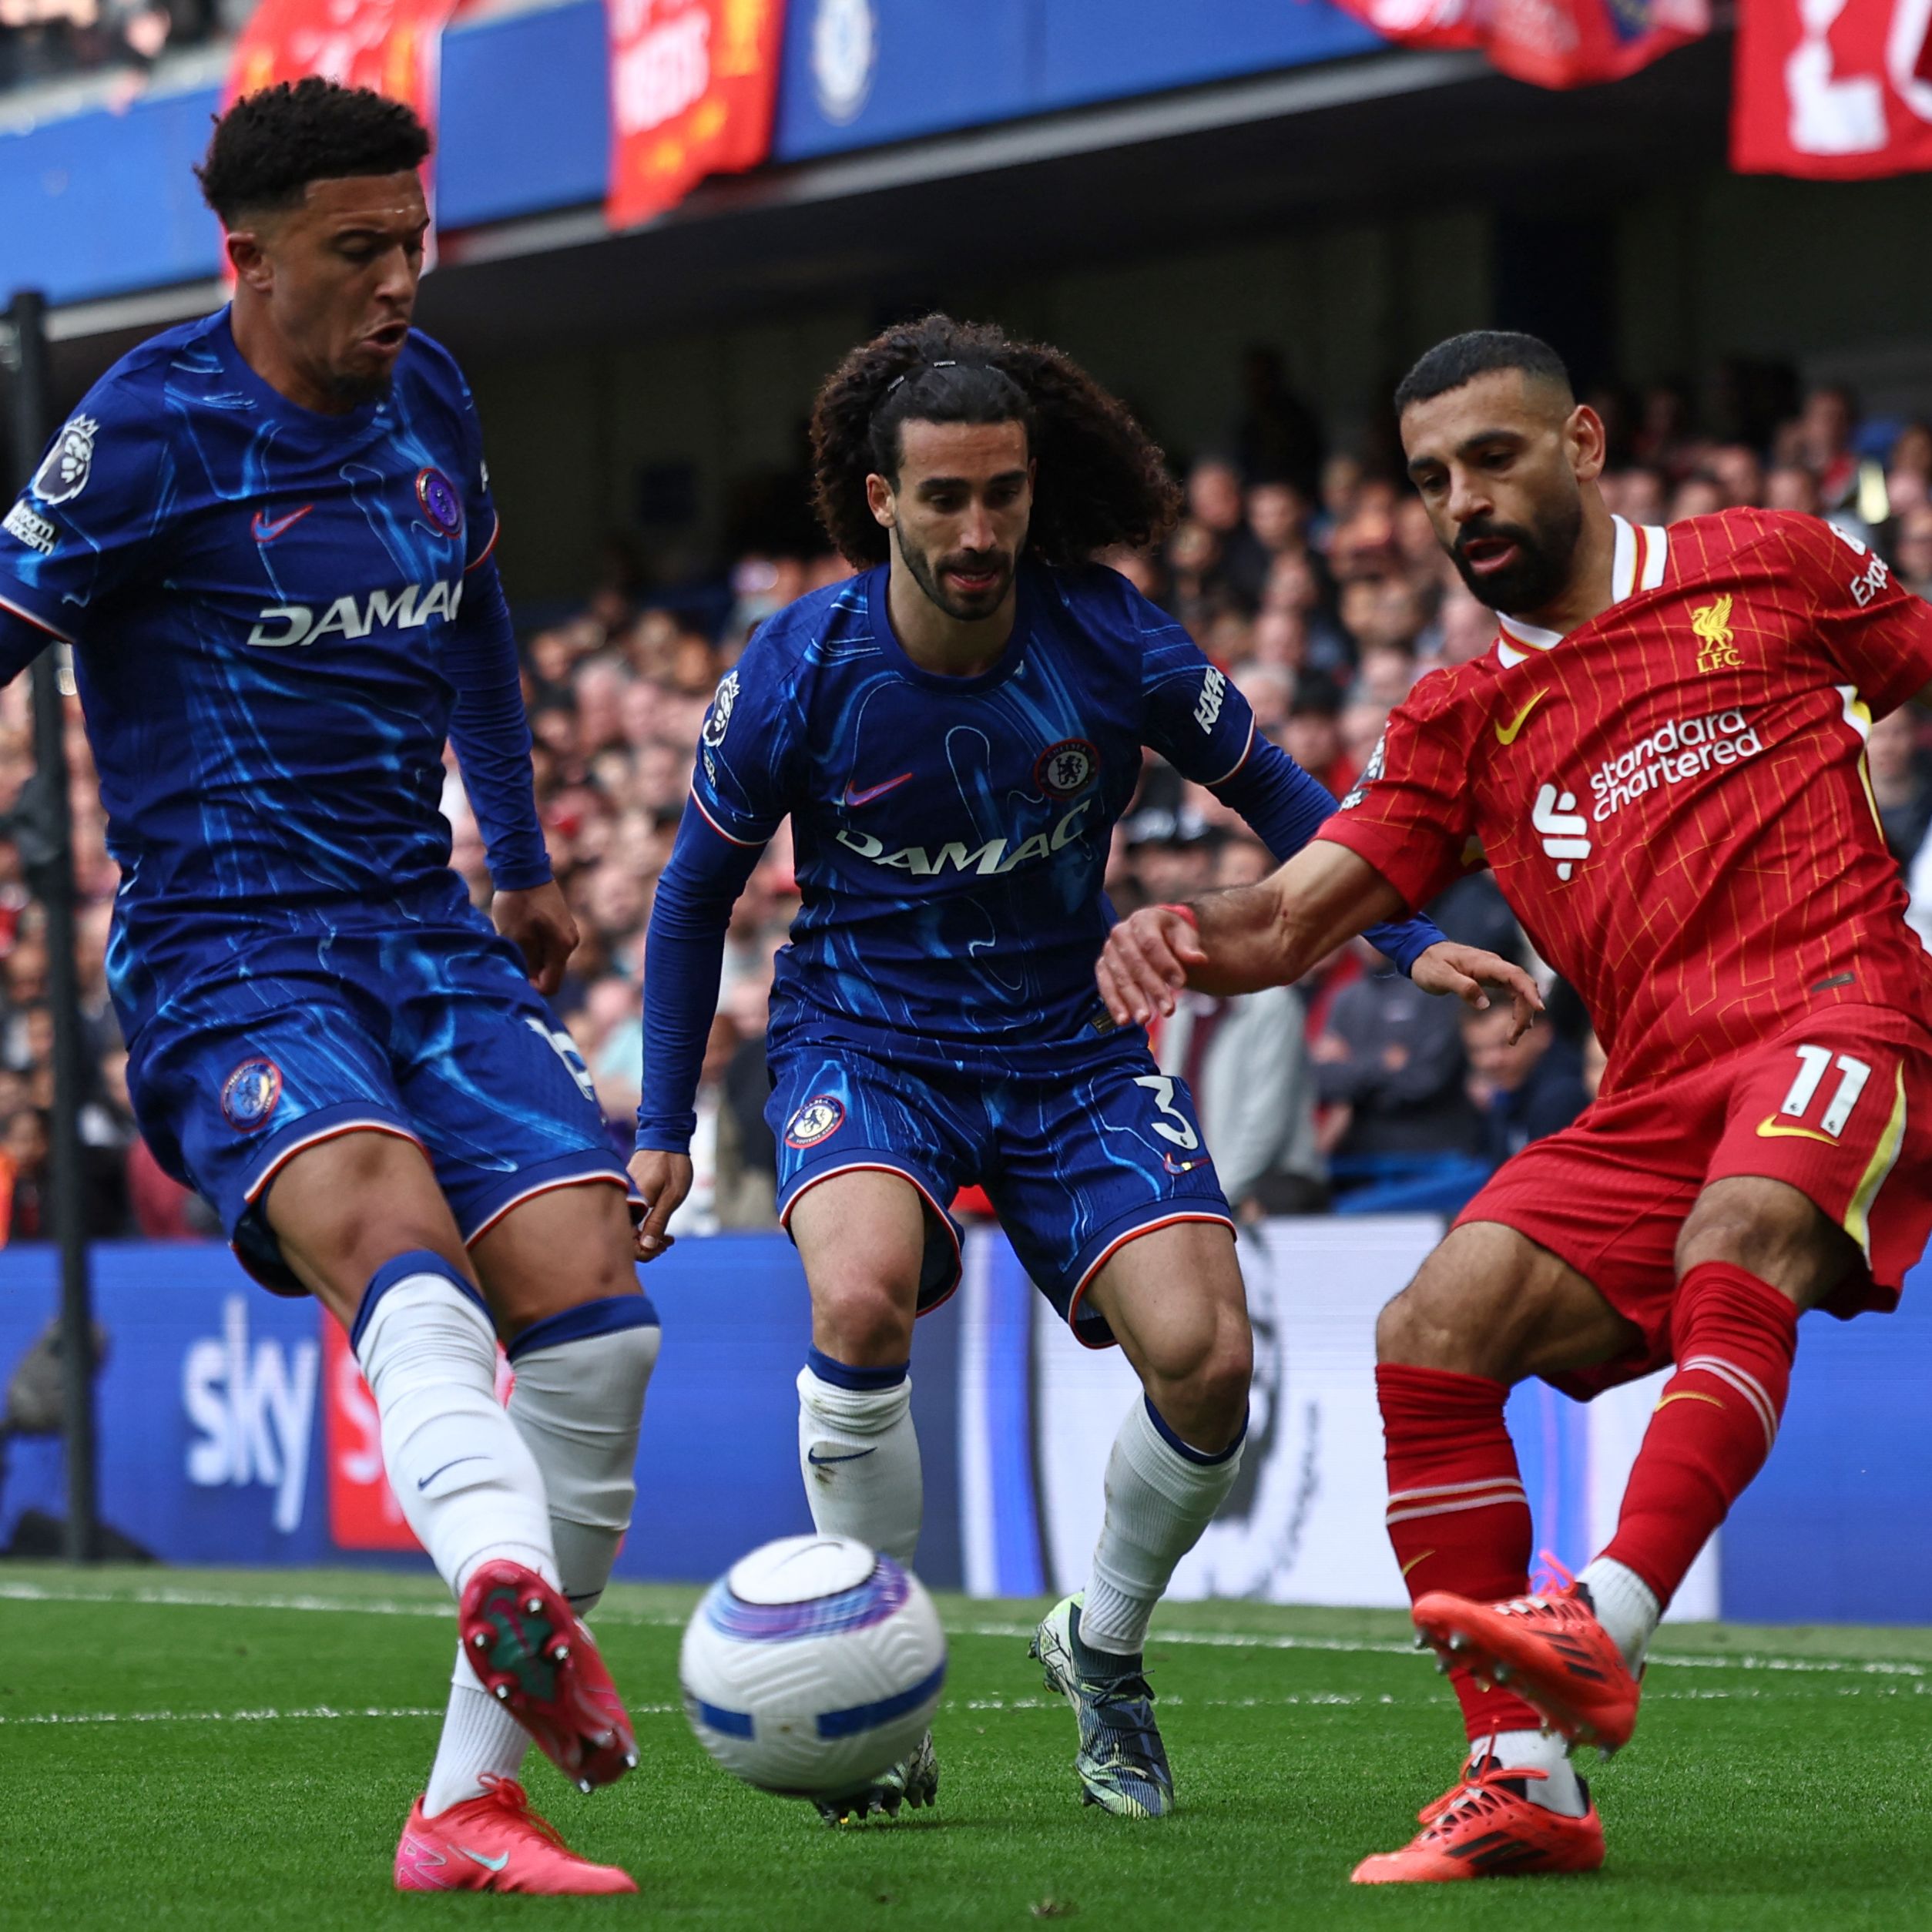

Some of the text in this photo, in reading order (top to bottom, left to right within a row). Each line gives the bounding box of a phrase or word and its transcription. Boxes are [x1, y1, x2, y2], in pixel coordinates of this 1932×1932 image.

[1193, 667, 1216, 724] LIVE
[1591, 706, 1746, 799] standard
[1593, 727, 1763, 822] chartered
[836, 799, 1091, 875] DAMAC
[1132, 1075, 1199, 1149] 3
[1781, 1044, 1872, 1138] 11
[183, 1294, 319, 1531] sky
